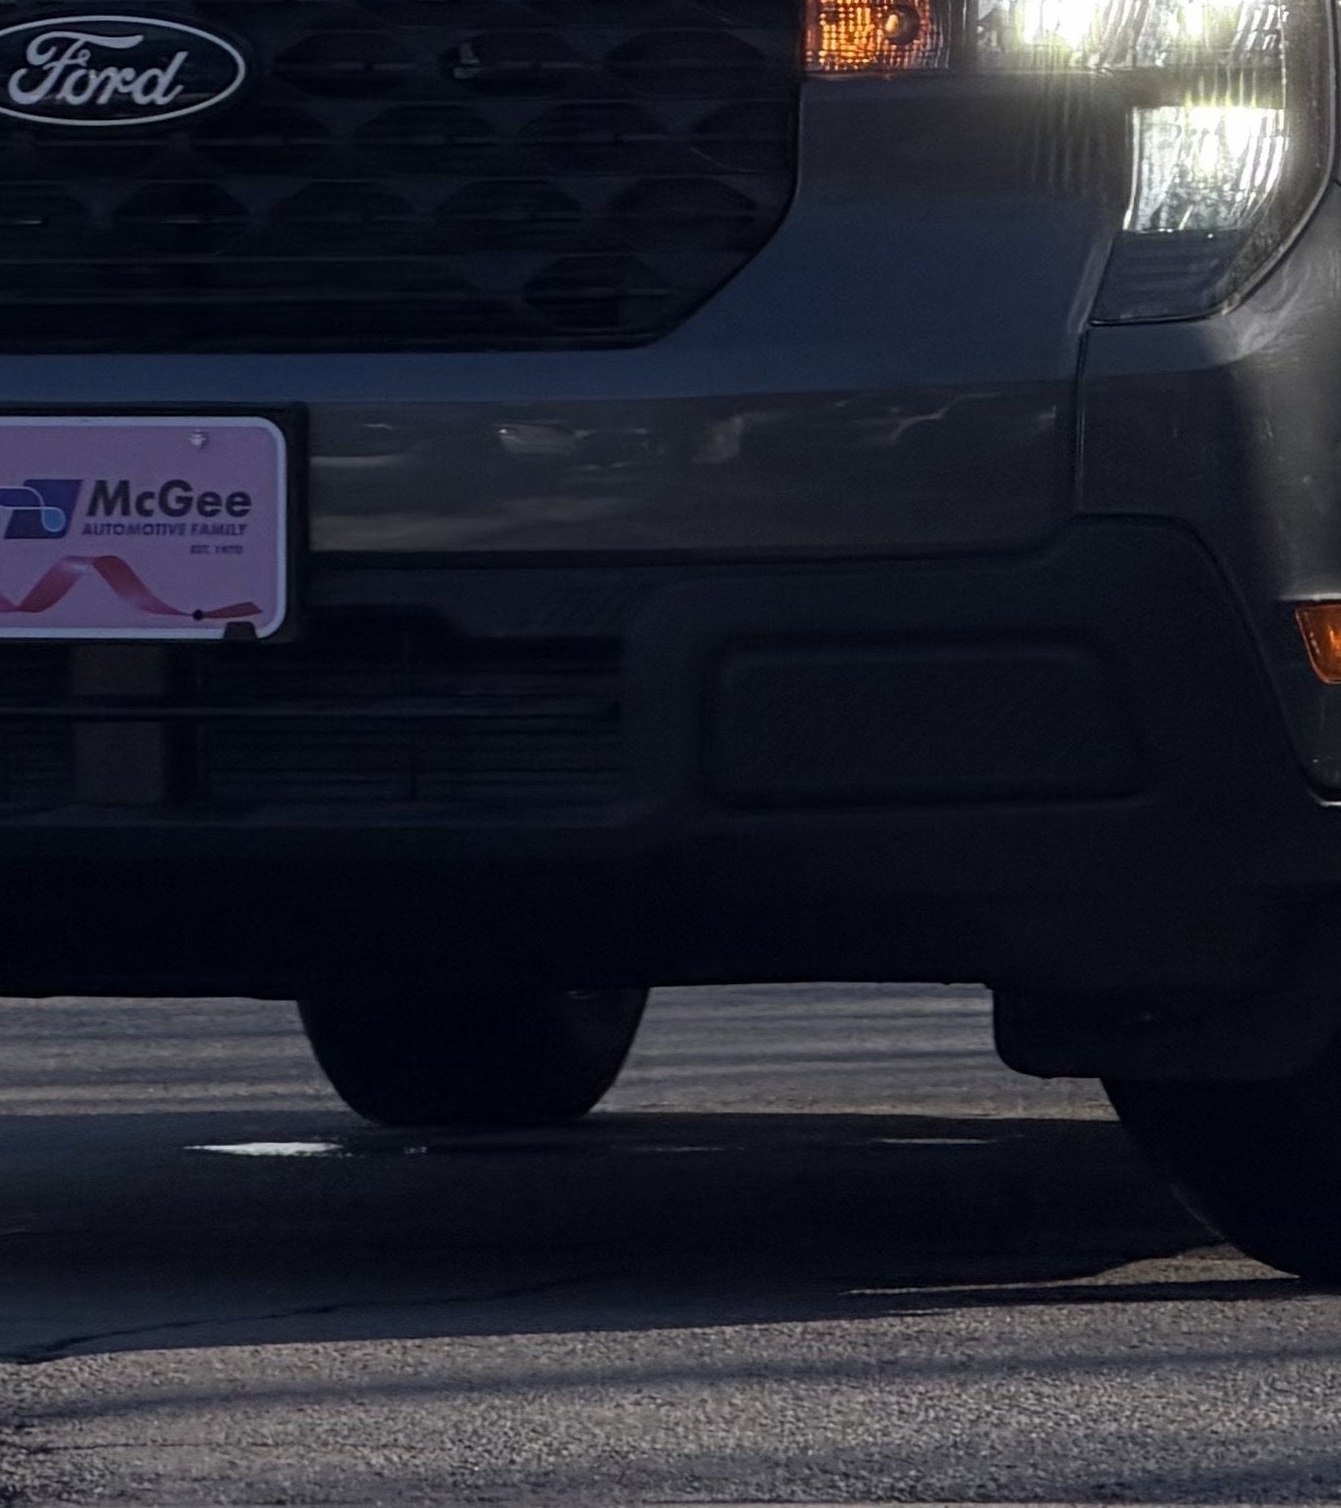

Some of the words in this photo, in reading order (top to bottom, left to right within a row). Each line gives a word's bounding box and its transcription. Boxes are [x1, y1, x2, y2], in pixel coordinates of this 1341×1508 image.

[9, 31, 188, 105] Ford
[87, 479, 252, 517] McGee
[81, 523, 187, 537] AUTOMOTIVE
[190, 523, 248, 537] FAMILY
